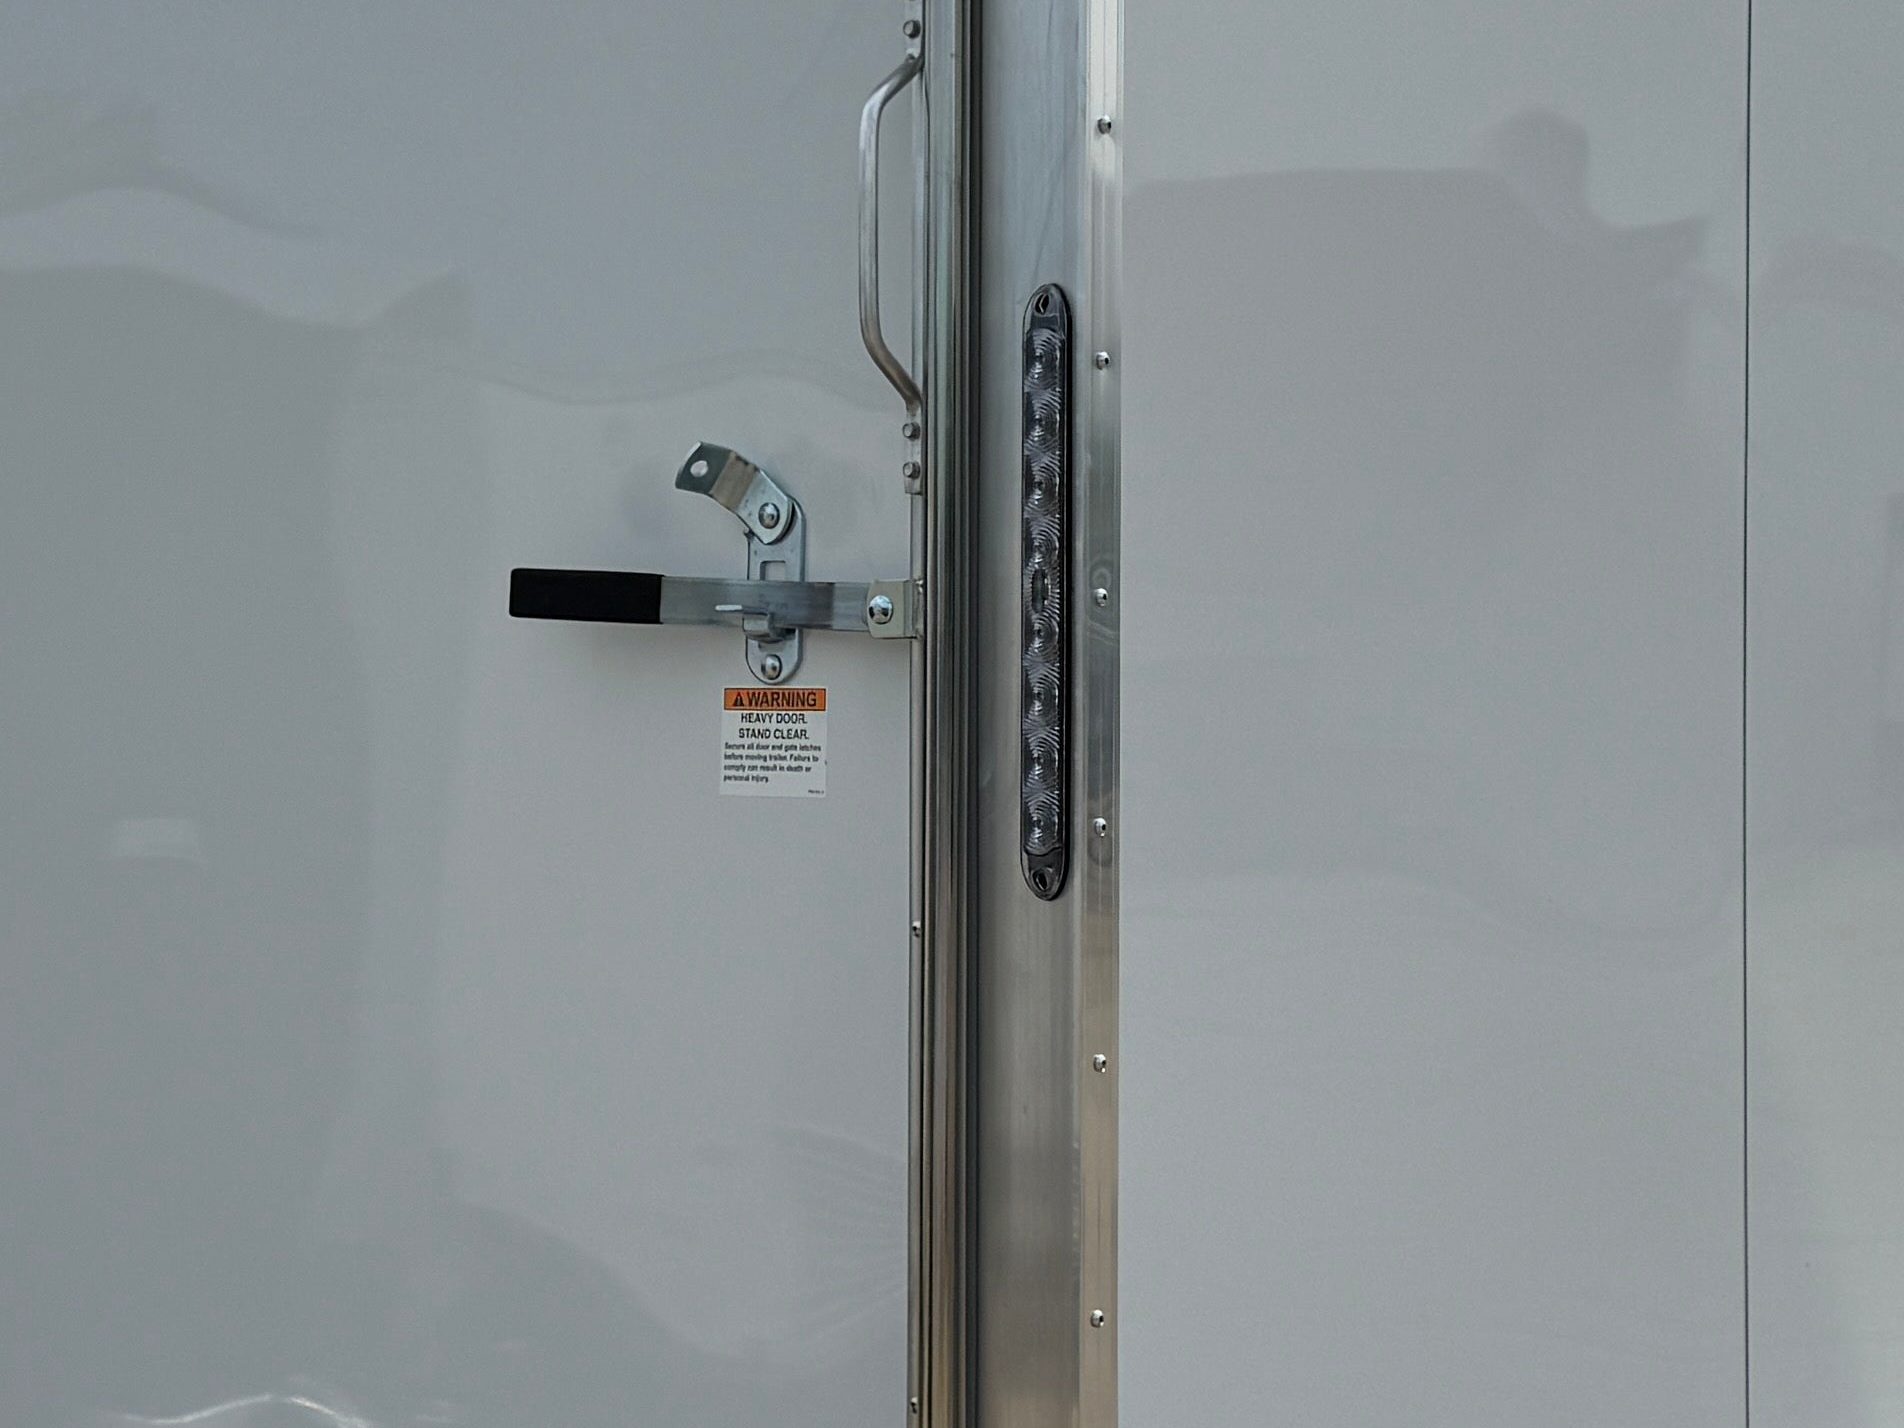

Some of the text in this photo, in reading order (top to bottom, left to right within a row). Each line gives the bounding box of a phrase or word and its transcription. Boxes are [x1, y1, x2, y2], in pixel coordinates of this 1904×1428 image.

[746, 691, 817, 708] WARNING
[741, 712, 774, 724] HEAVY
[739, 728, 771, 739] STAND
